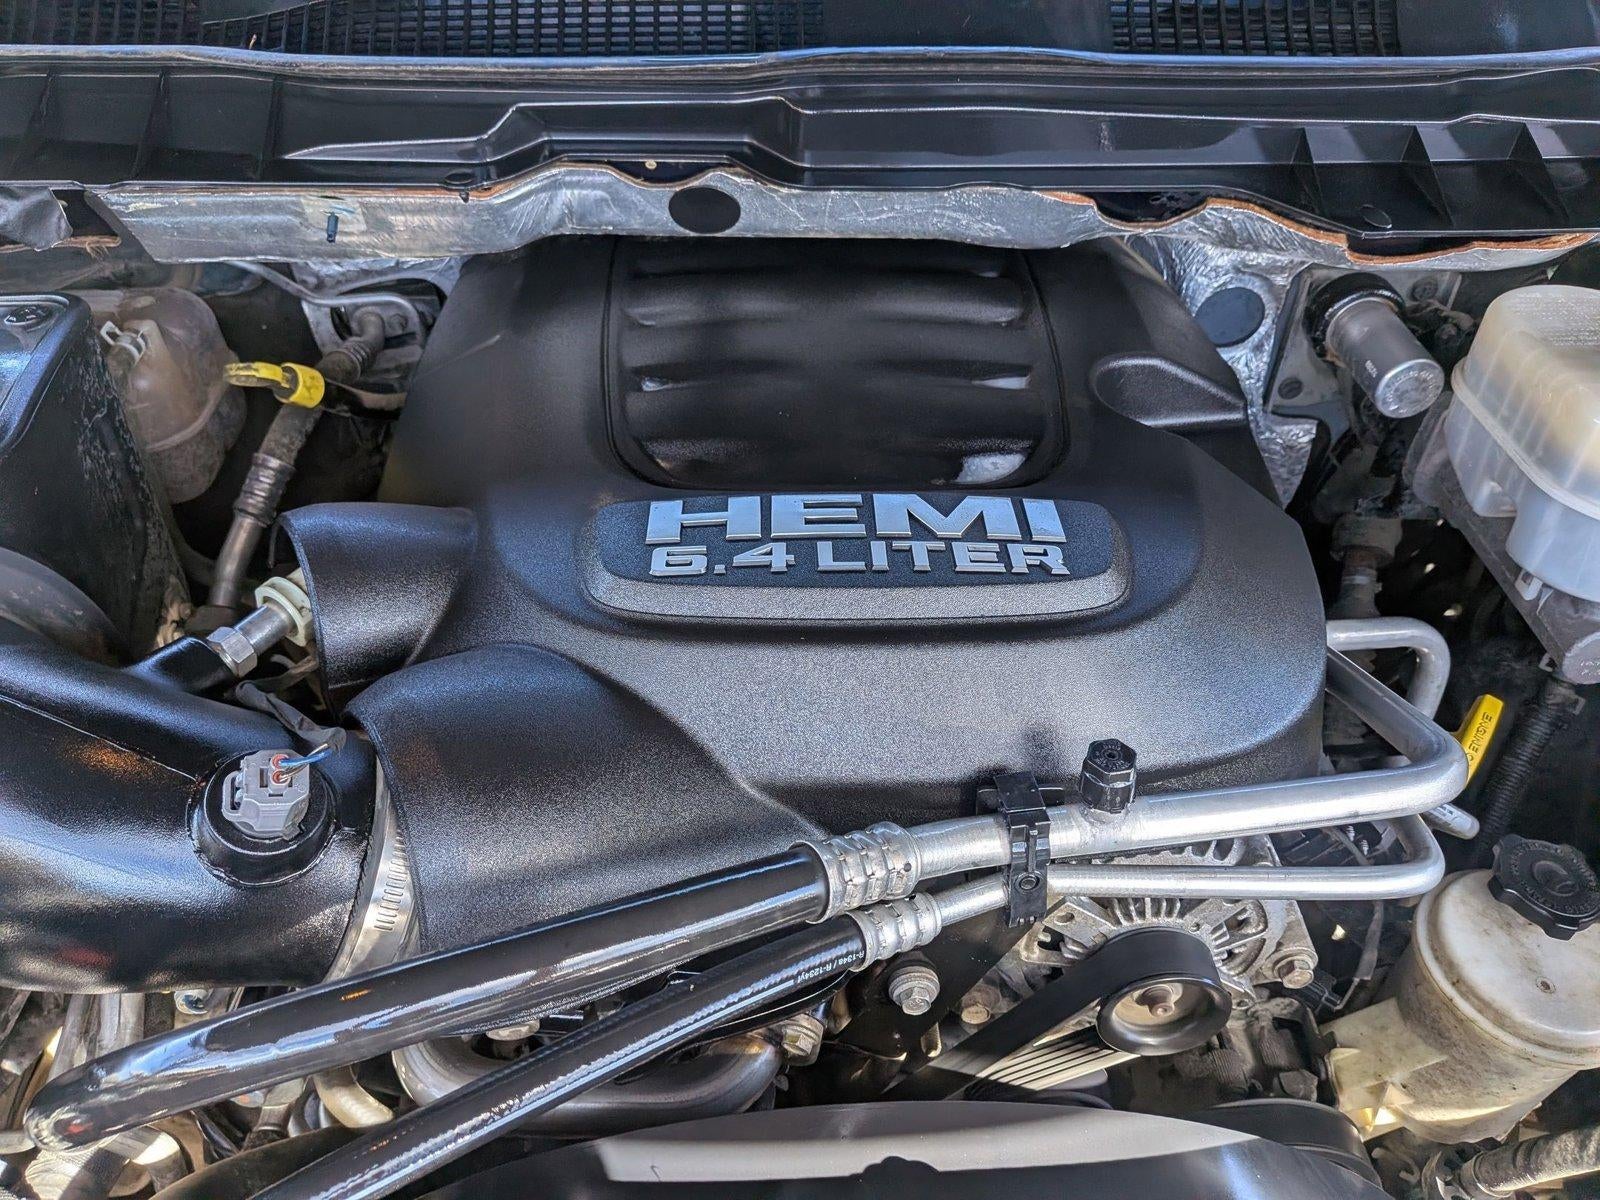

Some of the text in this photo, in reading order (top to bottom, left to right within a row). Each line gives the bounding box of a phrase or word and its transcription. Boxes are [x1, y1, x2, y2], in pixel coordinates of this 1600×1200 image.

[645, 494, 1067, 544] HEMI
[649, 540, 1071, 576] 6.4 LITER
[1468, 712, 1492, 753] ENGINE
[838, 950, 865, 965] R-134a
